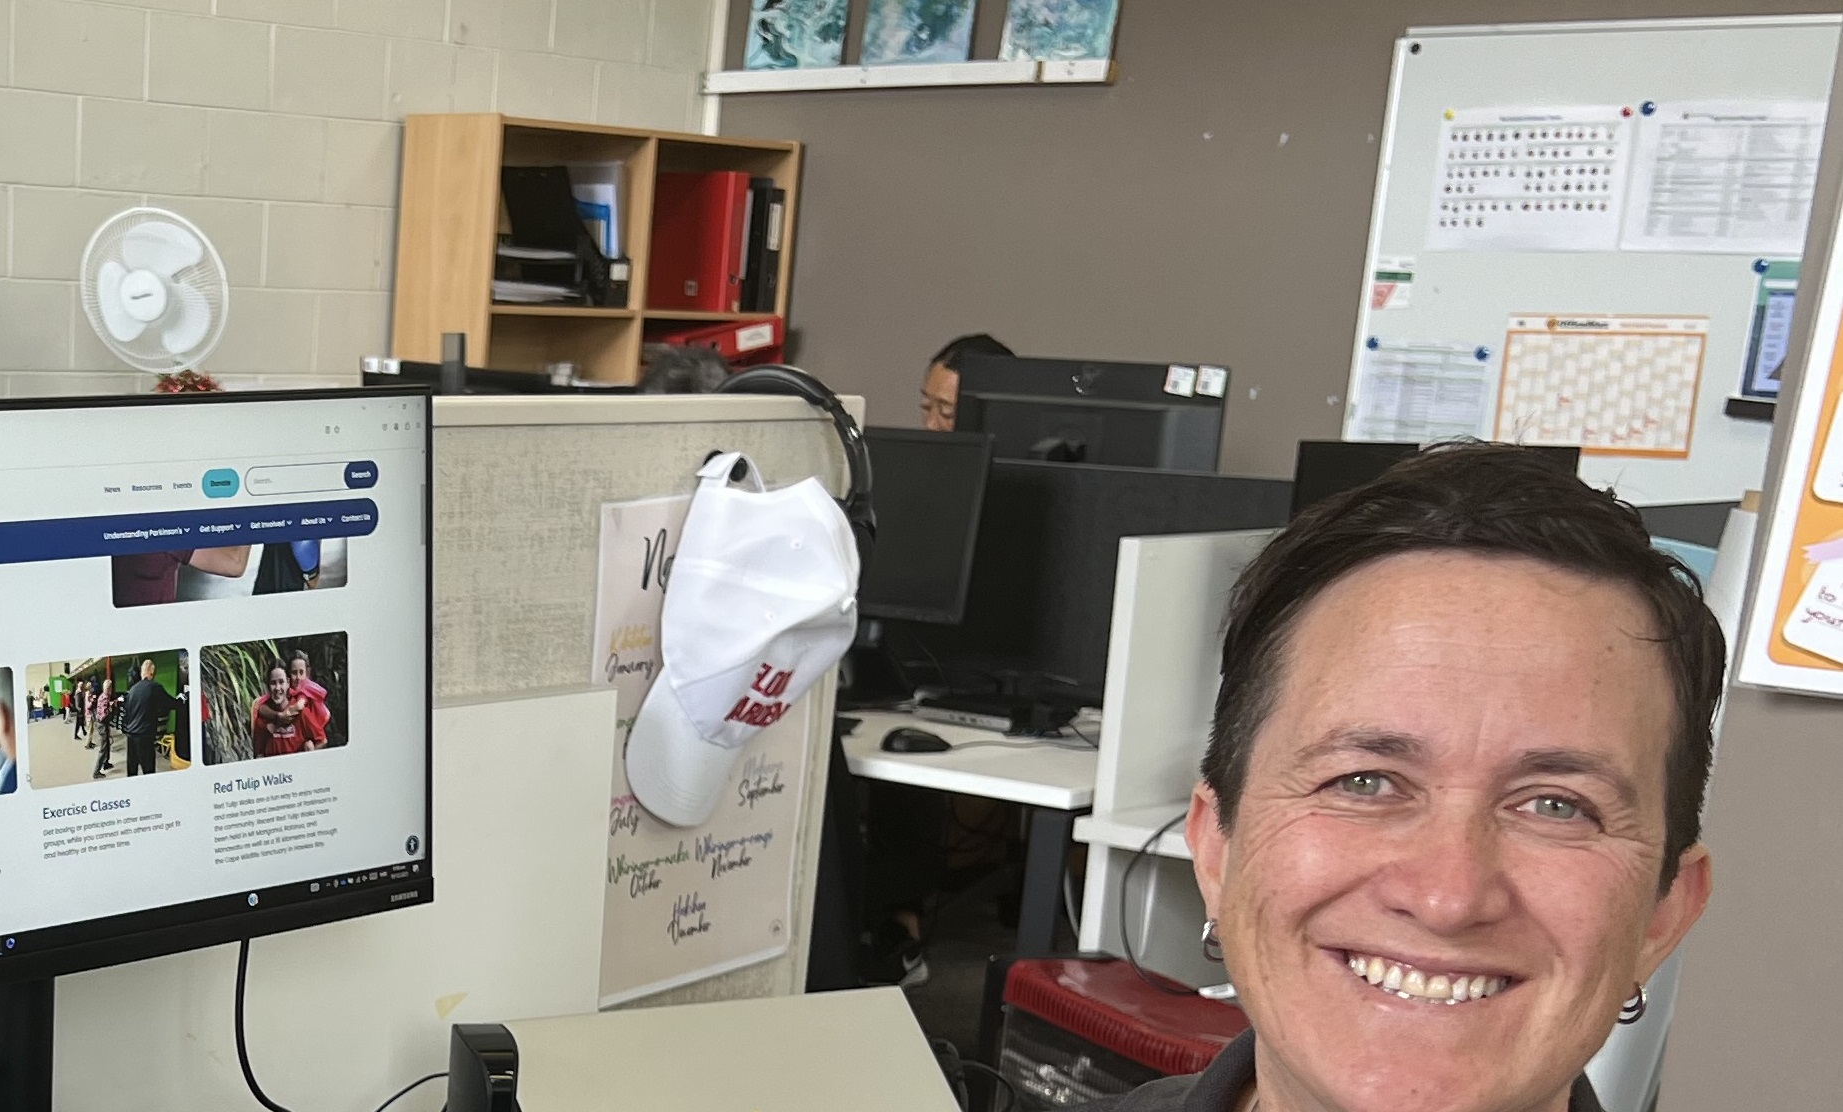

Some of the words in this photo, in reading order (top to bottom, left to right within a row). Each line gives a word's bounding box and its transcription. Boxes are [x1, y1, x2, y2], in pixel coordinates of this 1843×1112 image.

[103, 529, 148, 542] Understanding
[214, 781, 232, 794] Red
[236, 778, 260, 790] Tulip
[262, 773, 293, 786] Walks
[43, 803, 87, 819] Exercise
[91, 799, 131, 812] Classes
[610, 805, 639, 836] July
